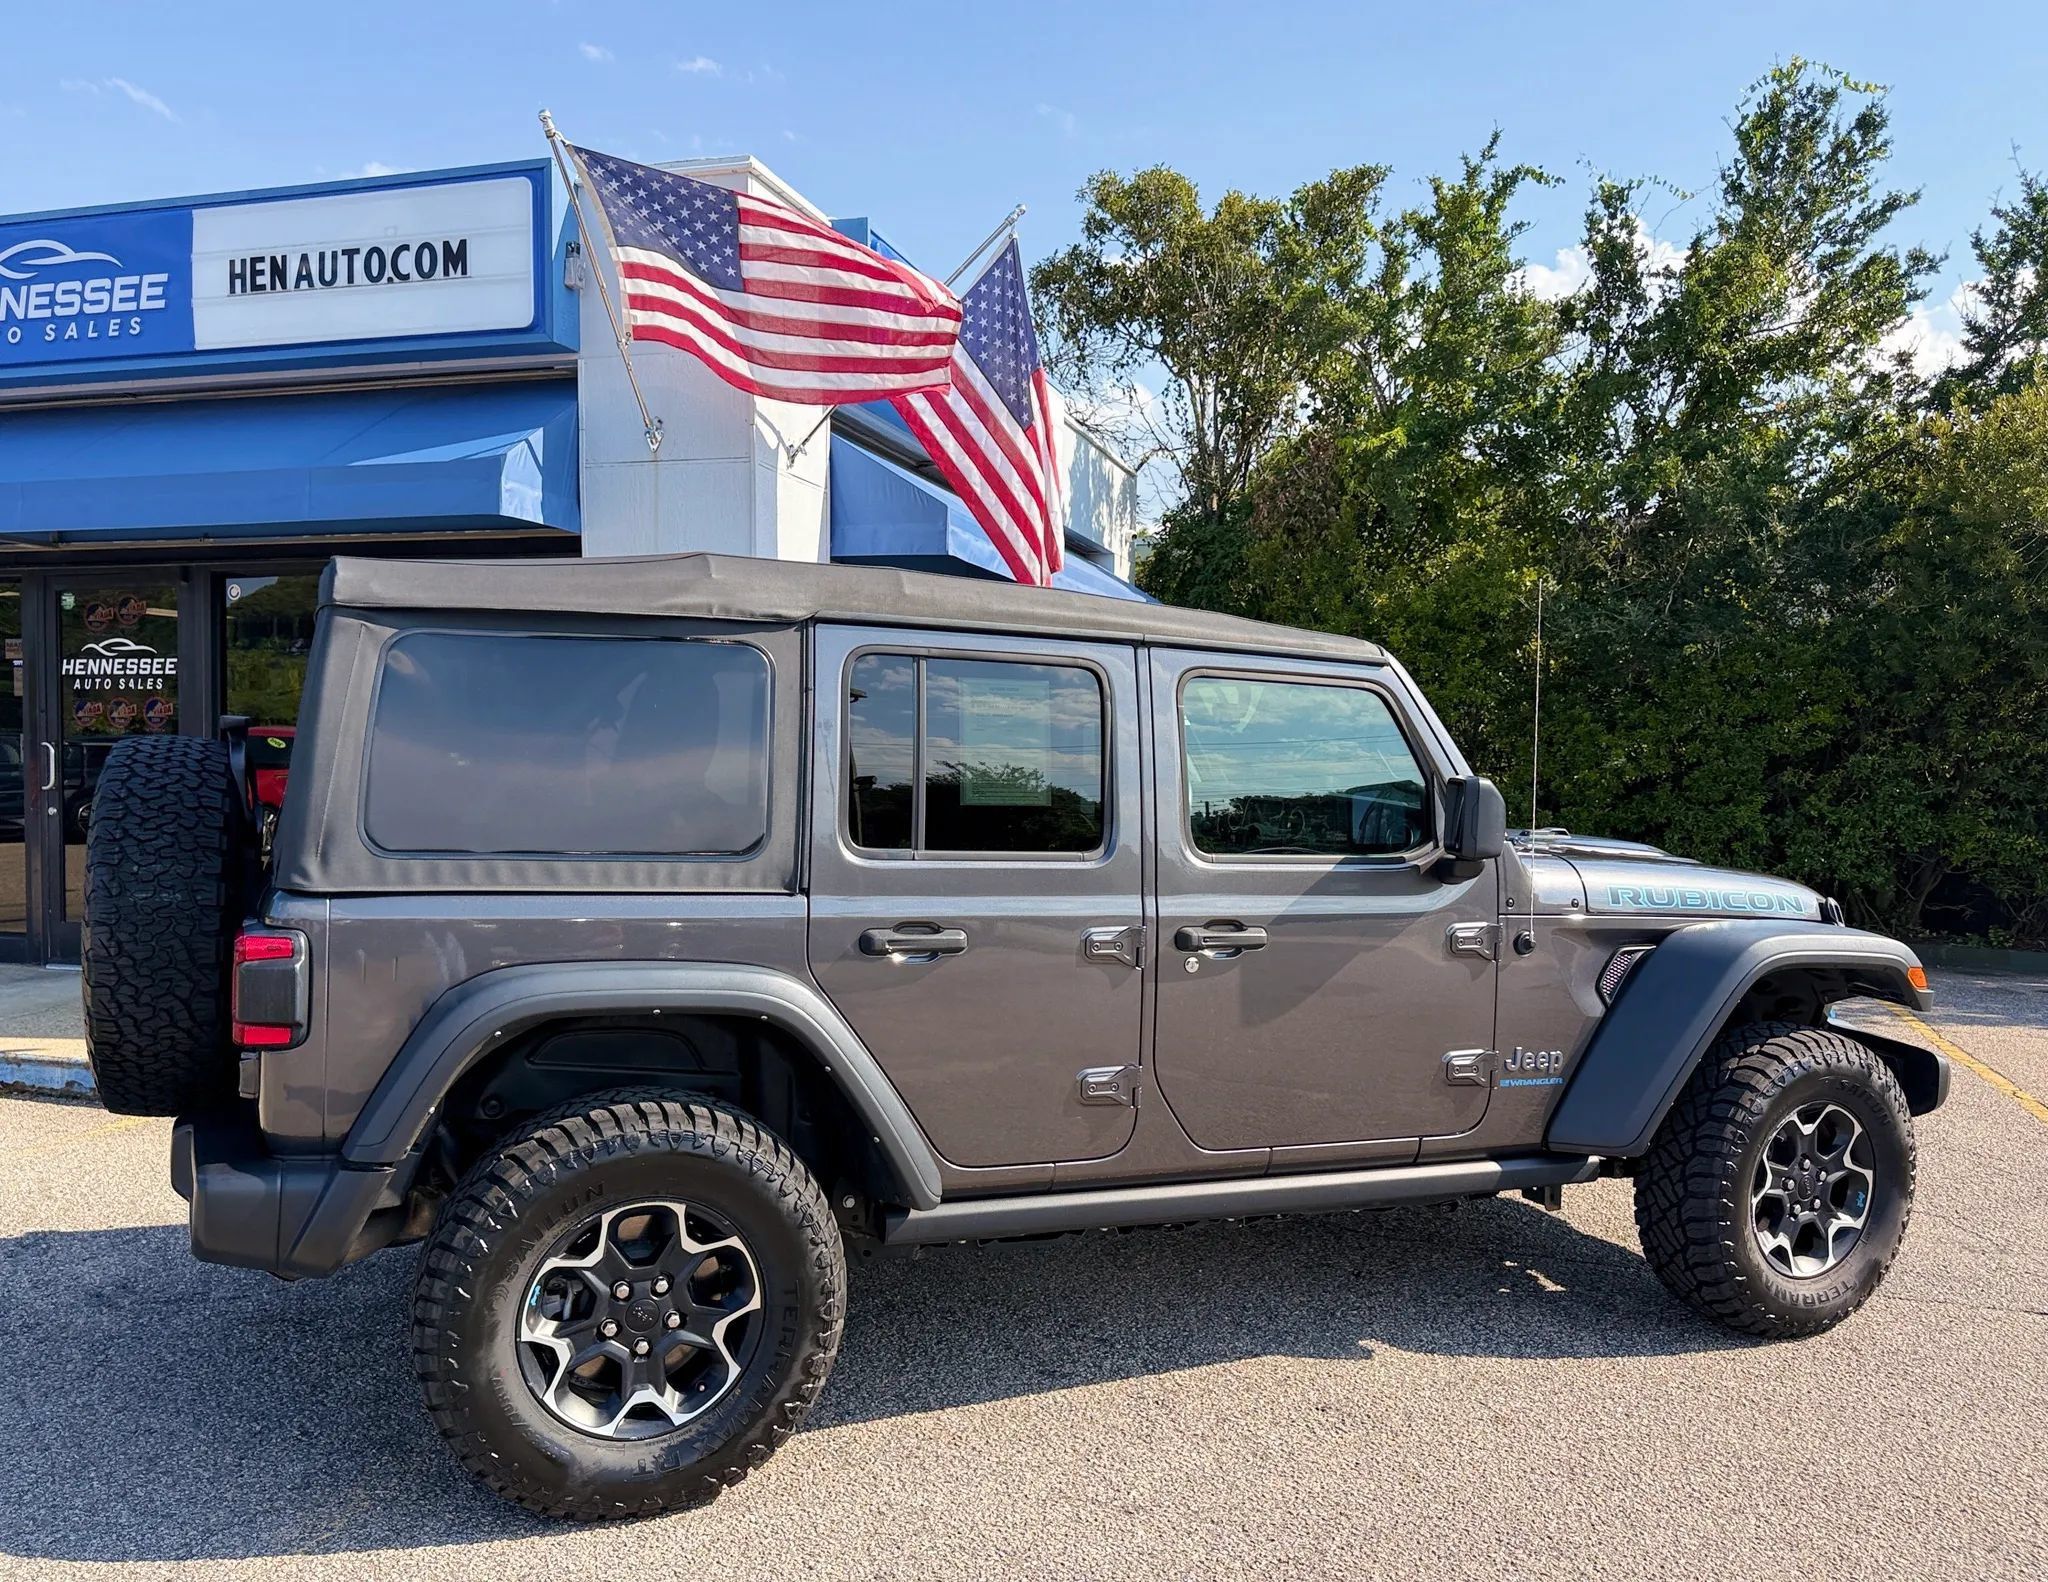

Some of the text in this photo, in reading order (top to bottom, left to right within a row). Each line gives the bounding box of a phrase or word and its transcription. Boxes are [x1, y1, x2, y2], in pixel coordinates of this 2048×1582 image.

[44, 316, 142, 342] SALES
[61, 658, 178, 675] HENNESSEE
[73, 678, 163, 690] AUTO SALES
[1607, 884, 1804, 914] RUBICON
[1504, 1046, 1564, 1073] Jeep
[1510, 1077, 1563, 1086] WRANGLER
[502, 1181, 604, 1283] SAILUN
